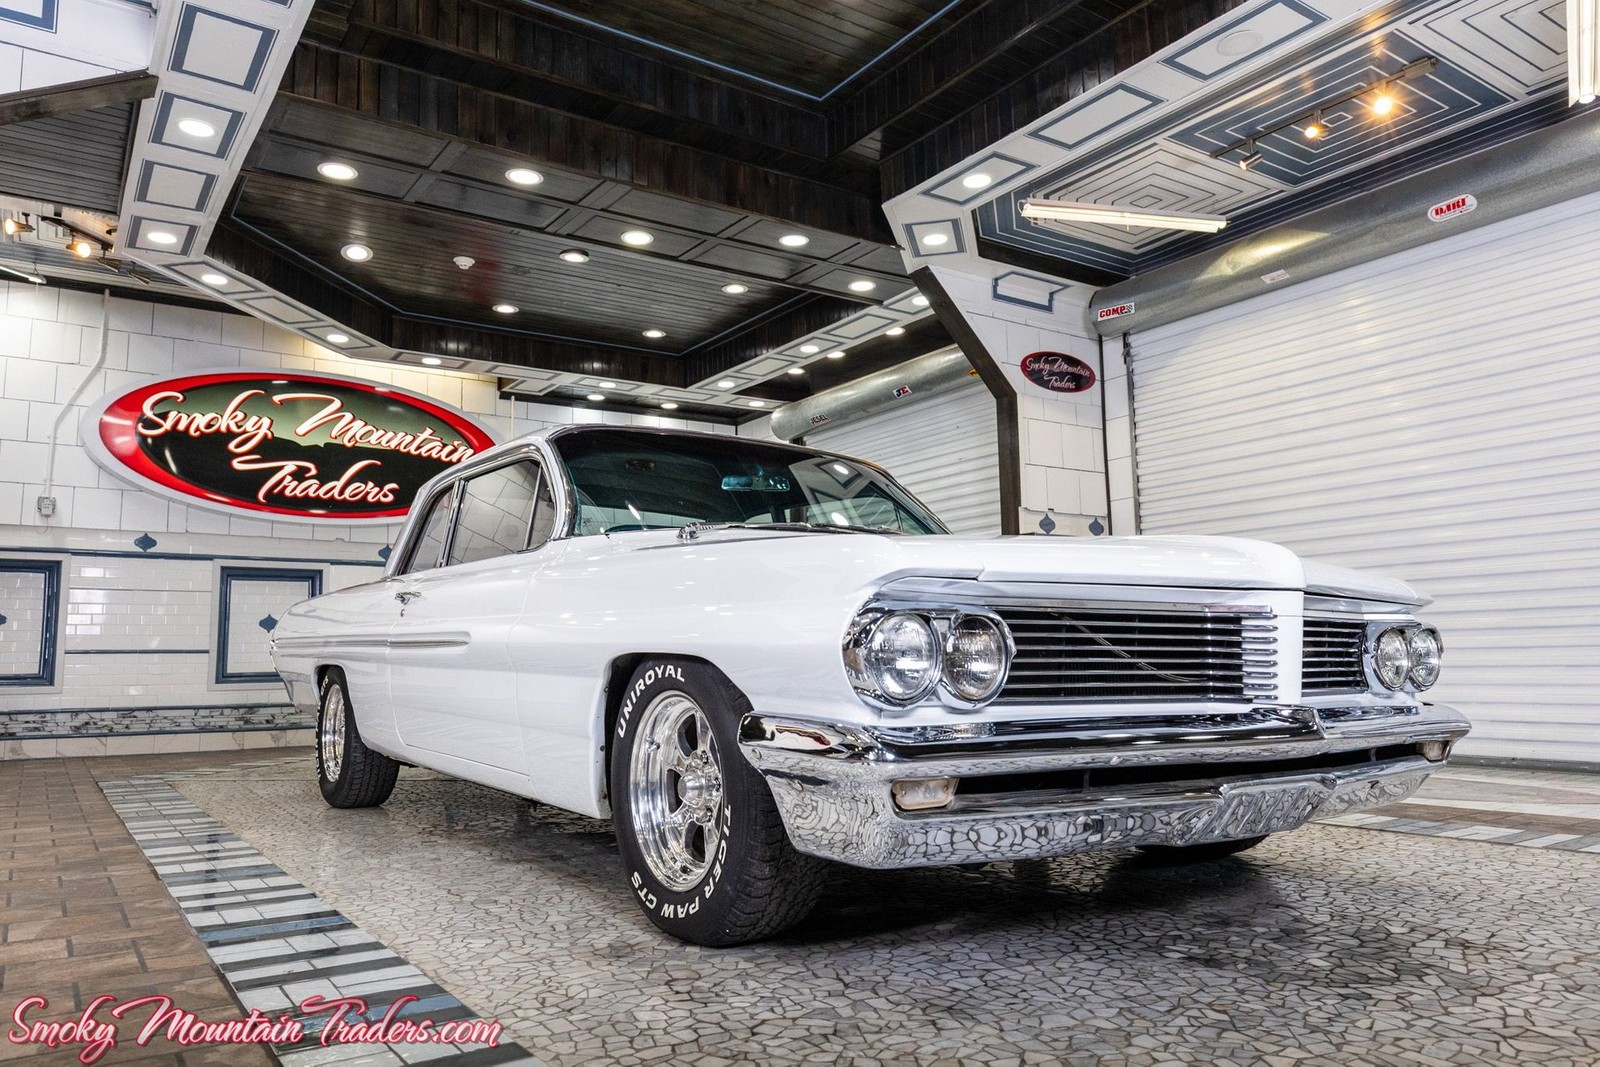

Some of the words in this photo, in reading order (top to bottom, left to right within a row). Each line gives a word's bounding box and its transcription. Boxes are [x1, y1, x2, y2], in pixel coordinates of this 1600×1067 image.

[1099, 305, 1126, 318] COMP
[1026, 356, 1050, 375] Smoky
[1048, 356, 1091, 377] Mountain
[896, 386, 909, 397] JE
[1043, 375, 1076, 389] Traders
[136, 389, 274, 454] Smoky
[271, 392, 475, 464] Mountain
[810, 414, 828, 426] JESEL
[230, 454, 401, 504] Traders
[617, 664, 685, 739] UNIROYAL
[704, 804, 731, 899] TIGER
[631, 871, 658, 910] GTS
[660, 896, 700, 919] PAW
